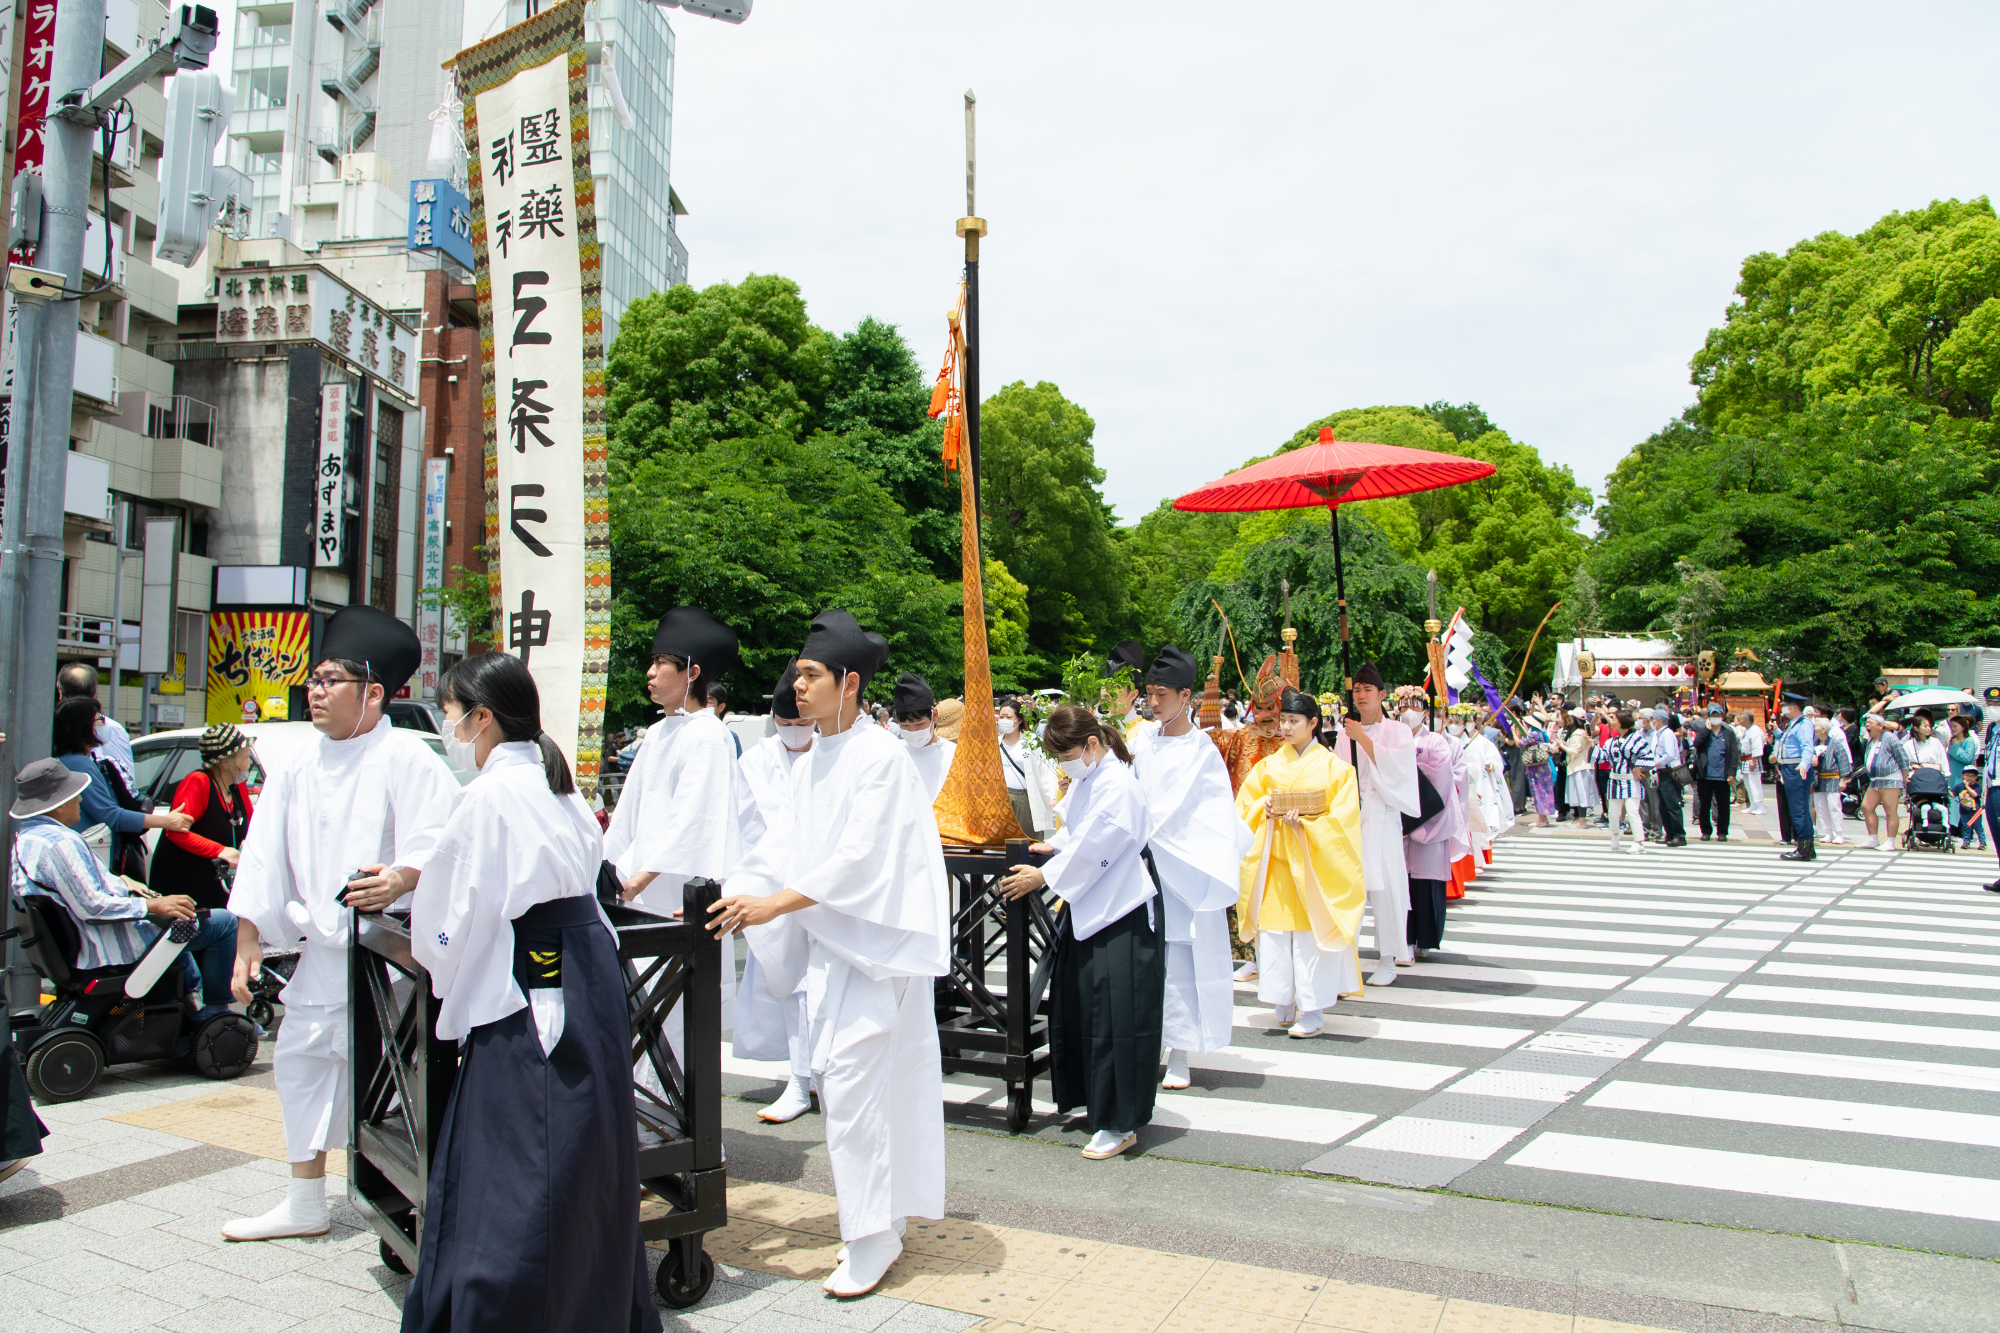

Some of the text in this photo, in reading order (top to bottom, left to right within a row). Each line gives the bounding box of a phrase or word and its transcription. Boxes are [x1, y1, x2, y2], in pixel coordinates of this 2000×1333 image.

[449, 205, 472, 243] ホテ
[226, 274, 309, 297] 北京料理
[346, 292, 397, 341] 北京料理
[319, 452, 341, 562] あずまや
